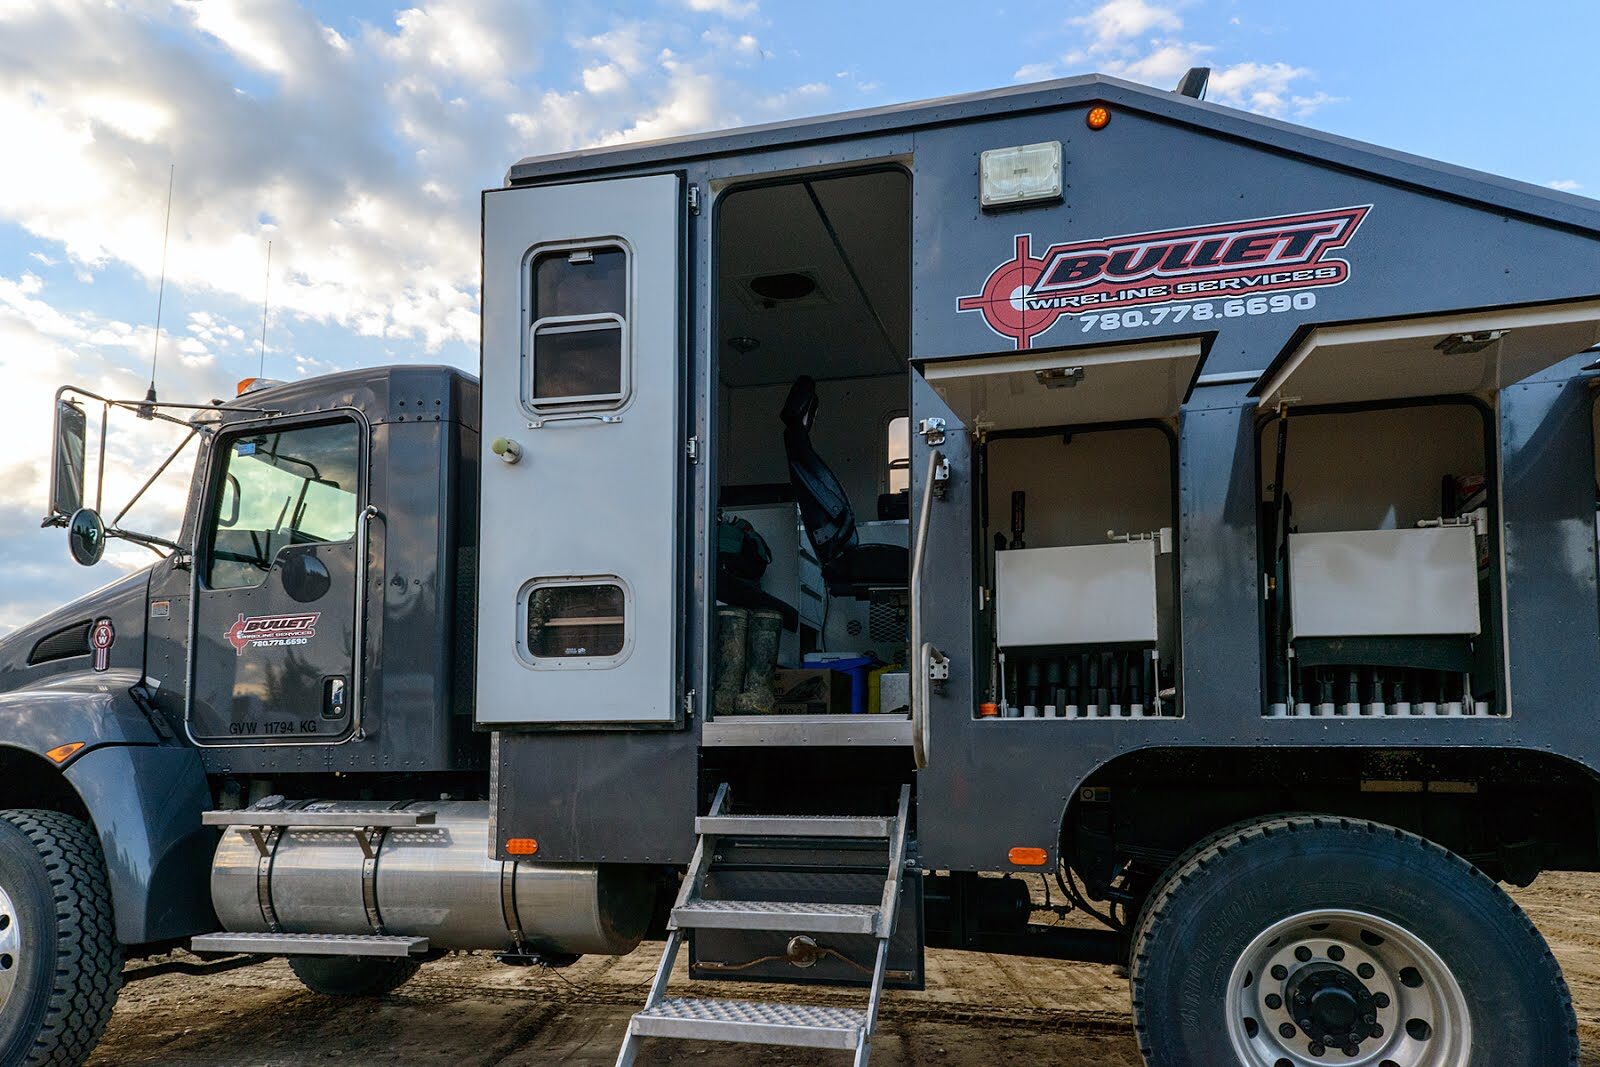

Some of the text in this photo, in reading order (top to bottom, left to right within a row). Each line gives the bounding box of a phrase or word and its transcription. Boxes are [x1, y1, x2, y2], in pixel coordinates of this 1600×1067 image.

[1043, 224, 1334, 286] BULLET
[1026, 267, 1338, 310] WIRELINE SERVICES
[1080, 292, 1316, 332] 780.778.6690
[246, 618, 314, 632] BULLET
[229, 720, 318, 735] GVW 11794 KG
